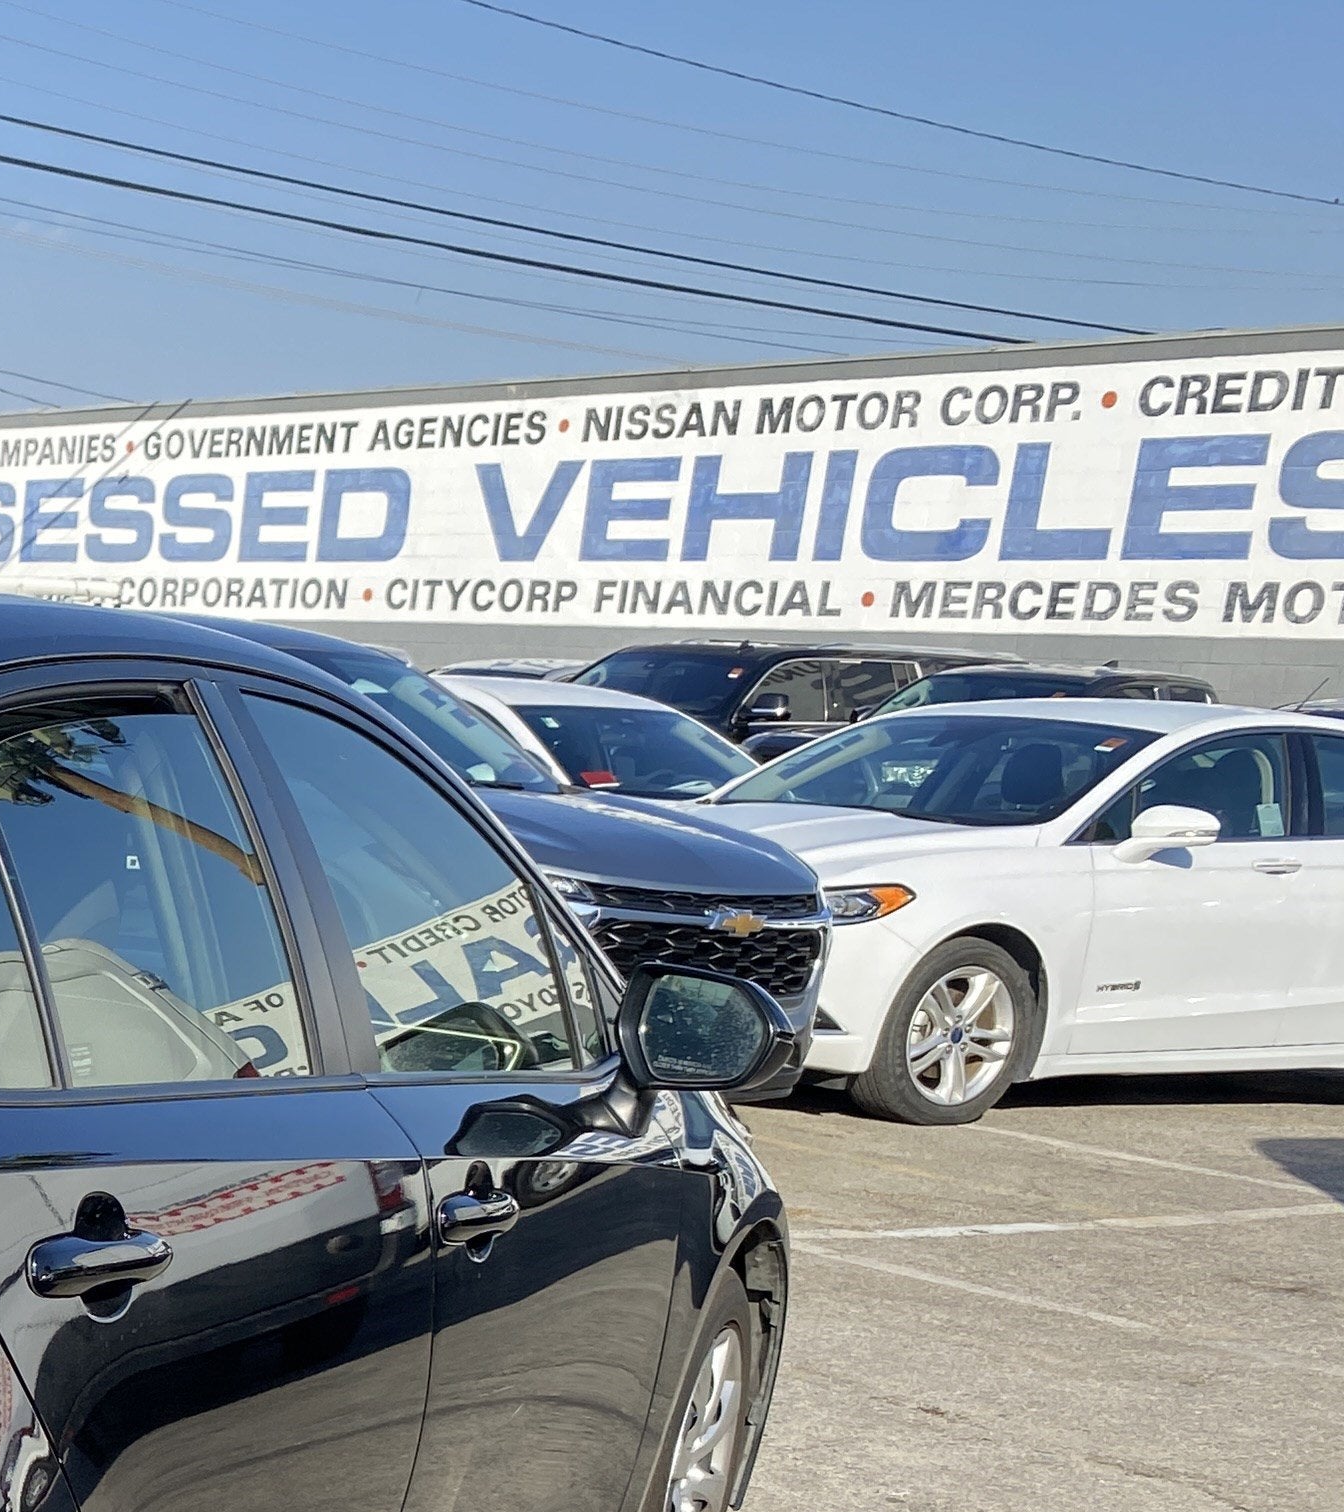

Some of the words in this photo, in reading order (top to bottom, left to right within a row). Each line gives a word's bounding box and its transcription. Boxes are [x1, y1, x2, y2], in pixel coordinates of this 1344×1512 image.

[143, 420, 360, 461] GOVERNMENT
[367, 409, 549, 452] AGENCIES
[581, 398, 743, 443] NISSAN
[754, 389, 923, 435] MOTOR
[940, 380, 1082, 427] CORP.
[1138, 366, 1344, 418] CREDIT
[474, 429, 1344, 564] VEHICLES
[118, 577, 350, 610] CORPORATION
[384, 577, 579, 613] CITYCORP
[593, 580, 842, 618] FINANCIAL
[888, 580, 1200, 623] MERCEDES
